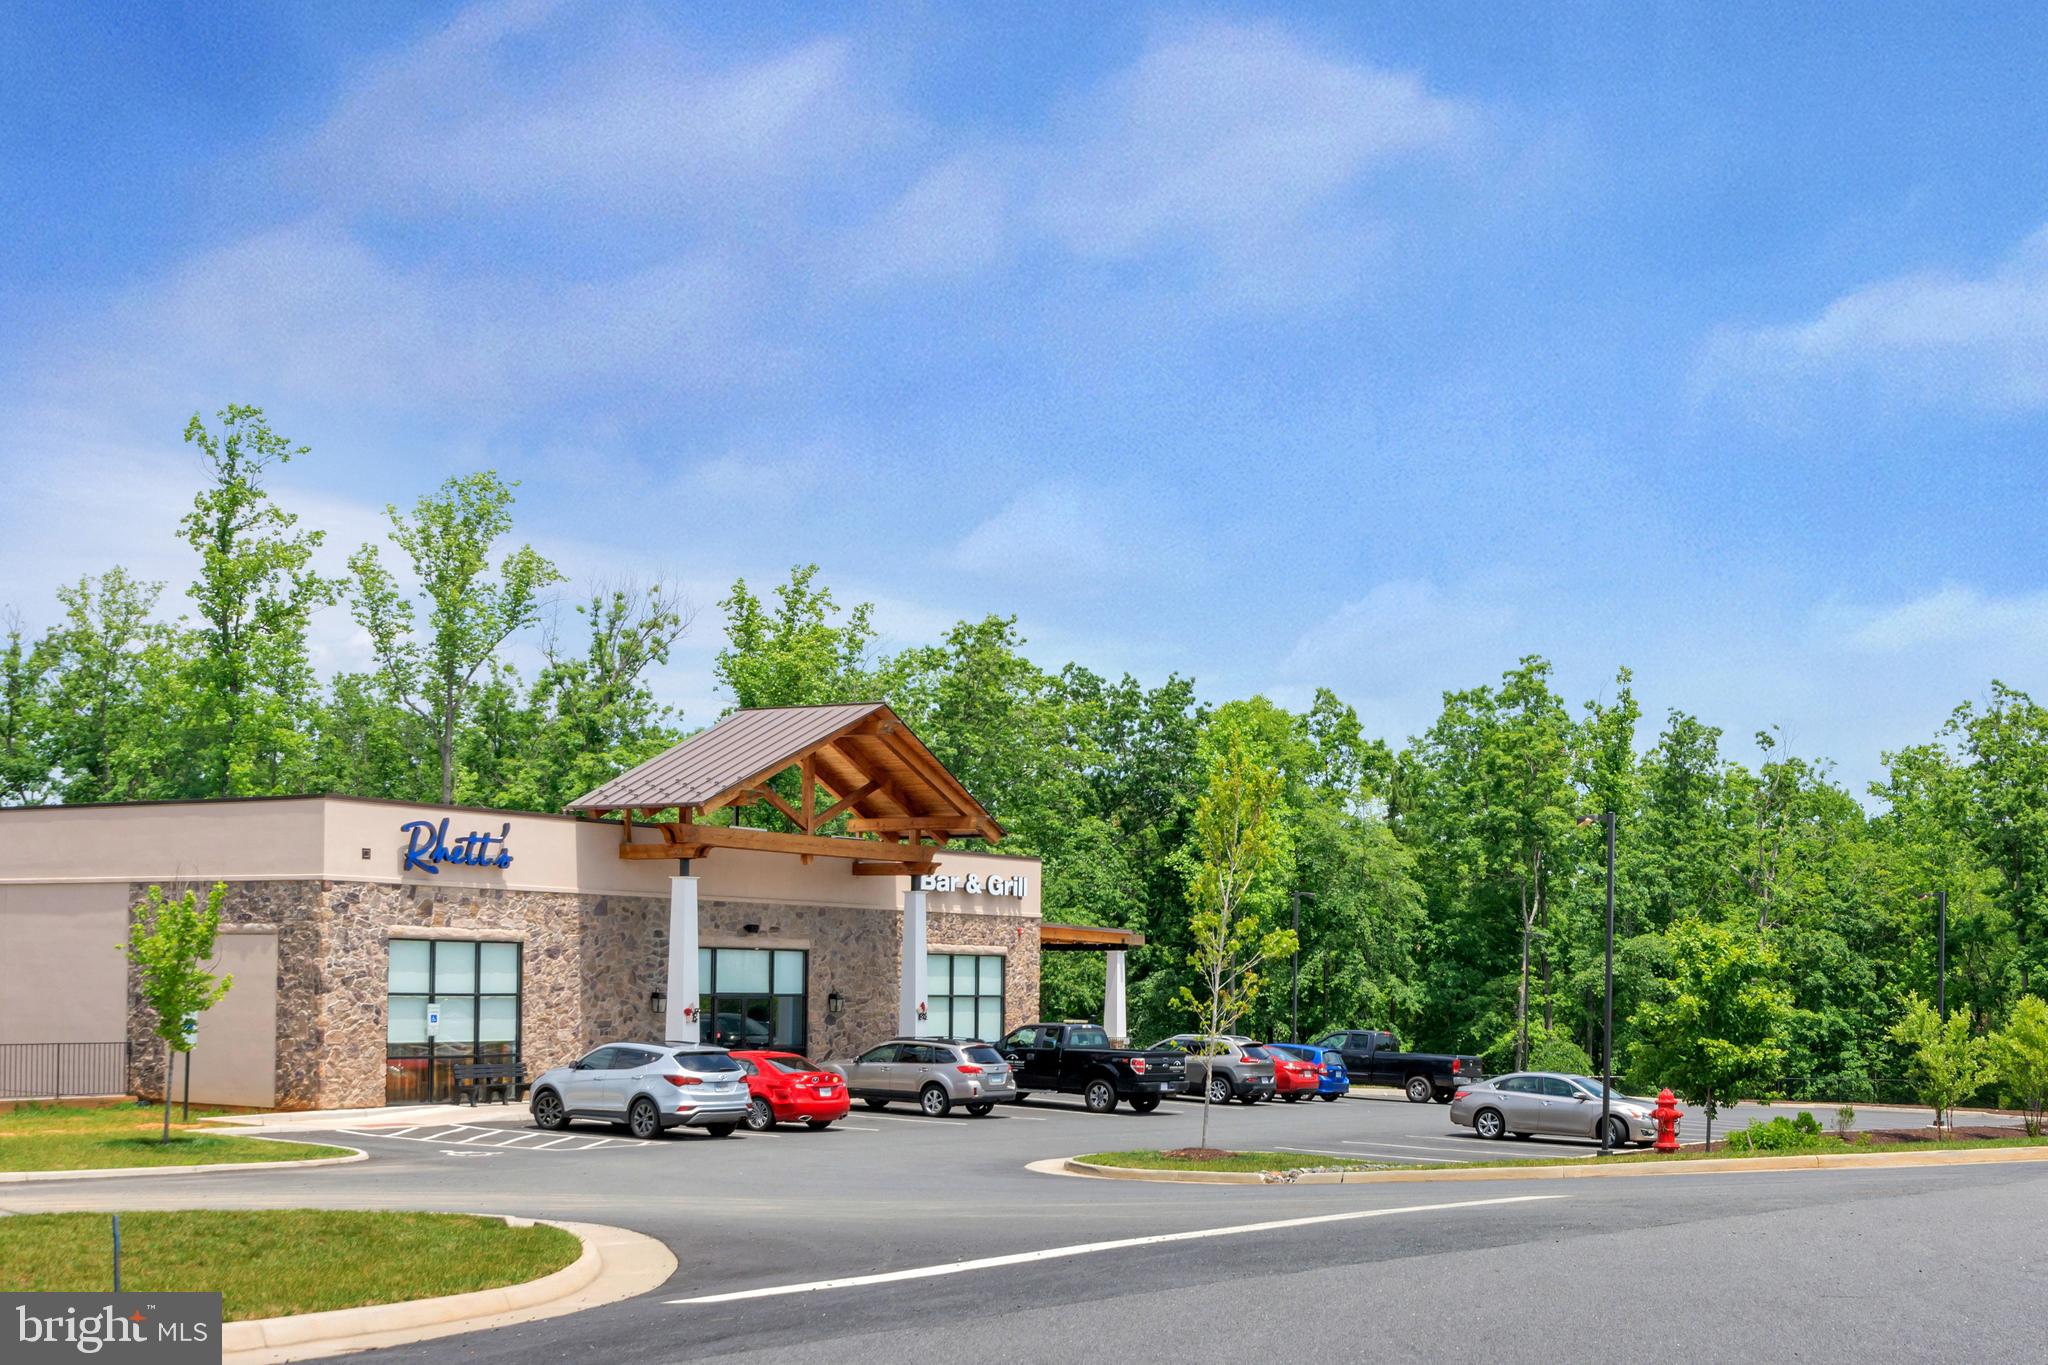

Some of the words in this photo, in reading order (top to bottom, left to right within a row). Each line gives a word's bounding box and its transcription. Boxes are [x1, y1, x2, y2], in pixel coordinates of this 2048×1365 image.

[401, 817, 513, 874] Rhett's
[920, 874, 960, 892] Bar
[964, 873, 982, 894] &
[986, 874, 1029, 897] Grill
